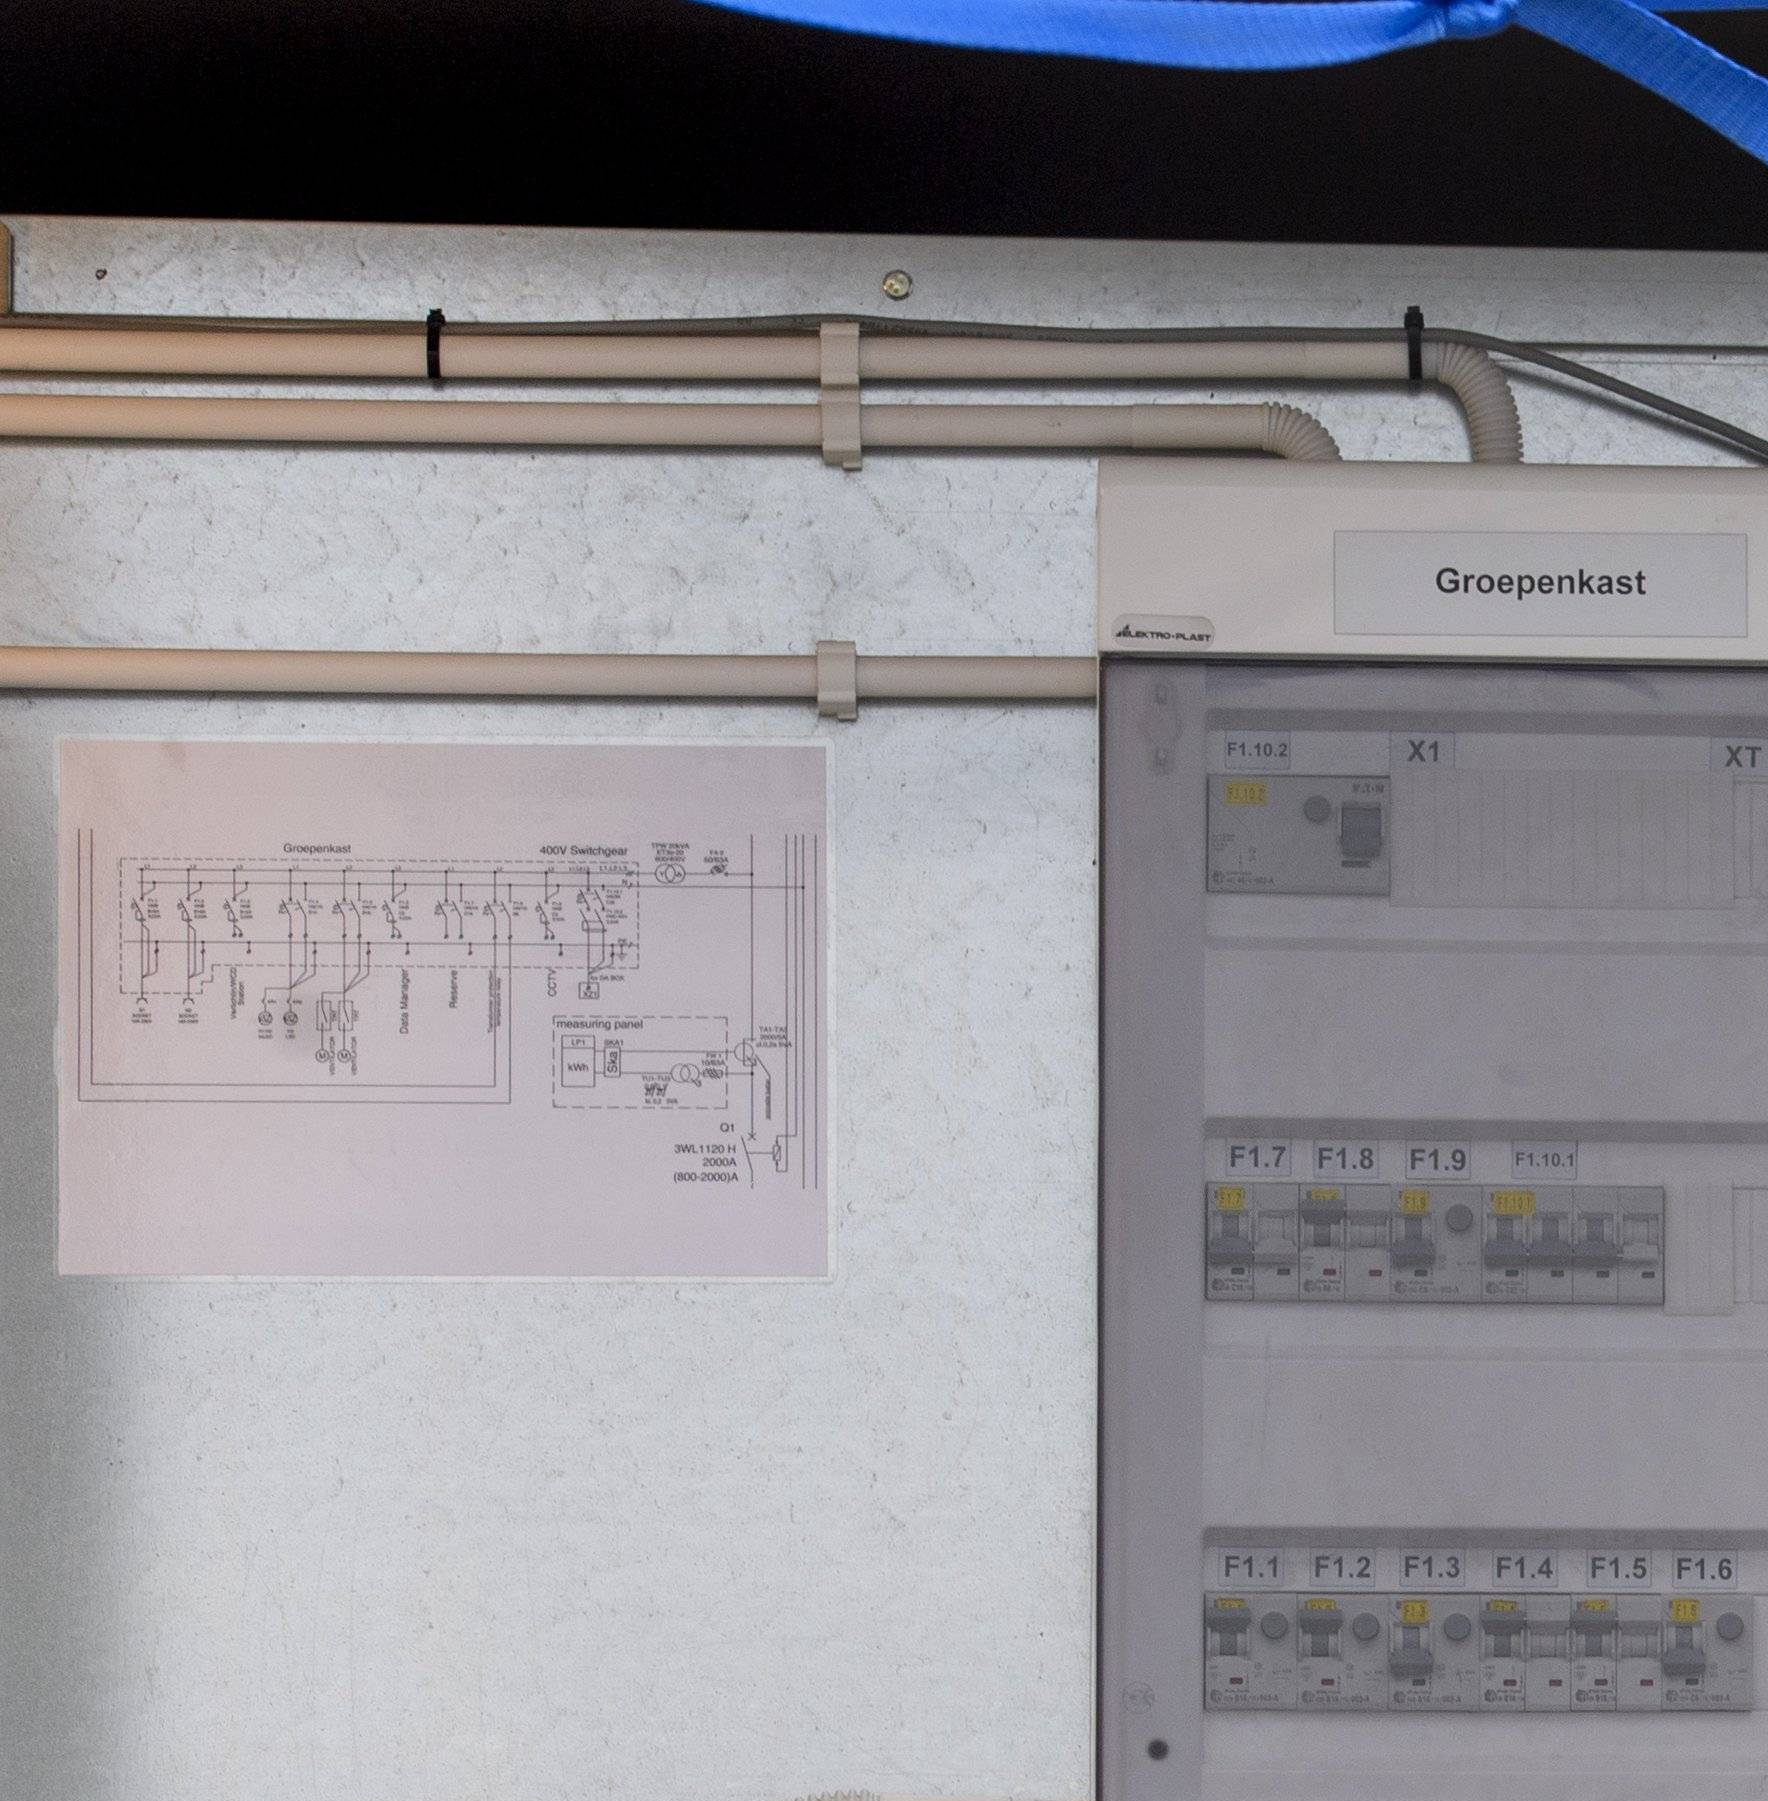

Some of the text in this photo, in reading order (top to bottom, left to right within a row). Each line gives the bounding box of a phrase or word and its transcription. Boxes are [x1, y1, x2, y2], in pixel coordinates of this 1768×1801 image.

[1435, 567, 1646, 600] Groepenkast
[1227, 742, 1288, 758] F1.10.2
[1406, 740, 1441, 763] X1
[1725, 745, 1763, 769] XT
[283, 843, 351, 855] Groepenkast
[540, 846, 628, 858] 400V Switchgear
[449, 970, 458, 1008] Reserve
[547, 968, 557, 997] CCTV
[400, 969, 411, 1034] Data Manager
[556, 1019, 643, 1030] measuring panel
[568, 1063, 589, 1073] kWh
[607, 1051, 618, 1074] Ska
[720, 1123, 735, 1133] Q1
[674, 1145, 736, 1154] 3WL1120 H
[1230, 1146, 1286, 1168] F1.7
[1318, 1147, 1374, 1170] F1.8
[1410, 1148, 1467, 1171] F1.9
[1515, 1152, 1574, 1168] F1.10.1
[703, 1158, 737, 1167] 2000A
[674, 1172, 739, 1183] (800-2000)A
[1224, 1555, 1278, 1578] F1.1
[1315, 1556, 1371, 1578] F1.2
[1404, 1556, 1460, 1578] F1.3
[1496, 1556, 1553, 1579] F1.4
[1591, 1556, 1647, 1579] F1.5
[1676, 1558, 1733, 1580] F1.6
